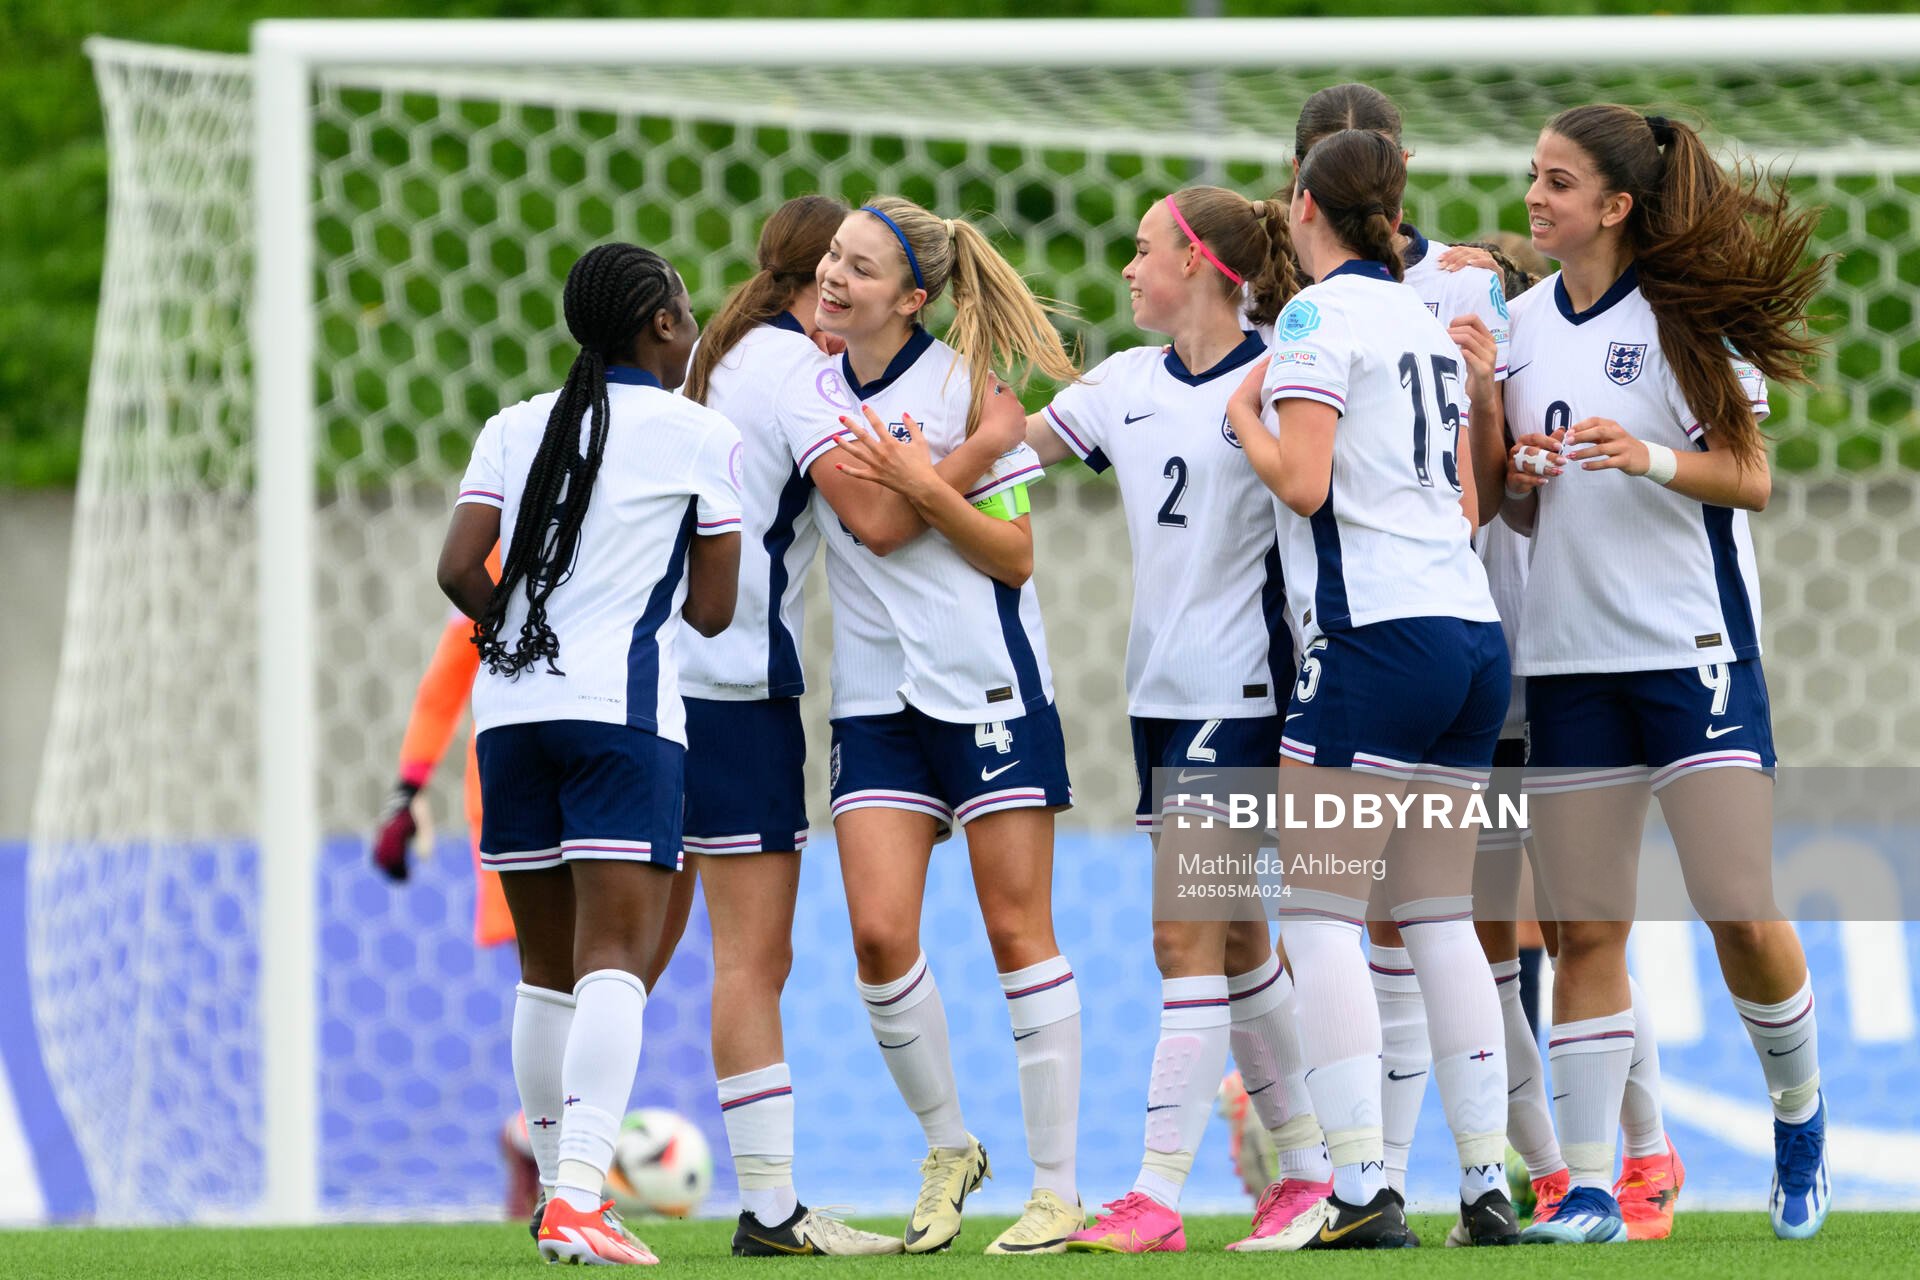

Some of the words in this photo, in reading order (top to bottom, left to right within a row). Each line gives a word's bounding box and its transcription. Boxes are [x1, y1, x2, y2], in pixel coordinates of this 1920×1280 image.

[1398, 352, 1462, 492] 15
[1157, 456, 1189, 528] 2
[1697, 662, 1731, 716] 9
[975, 720, 1013, 754] 4
[1186, 719, 1222, 762] 2
